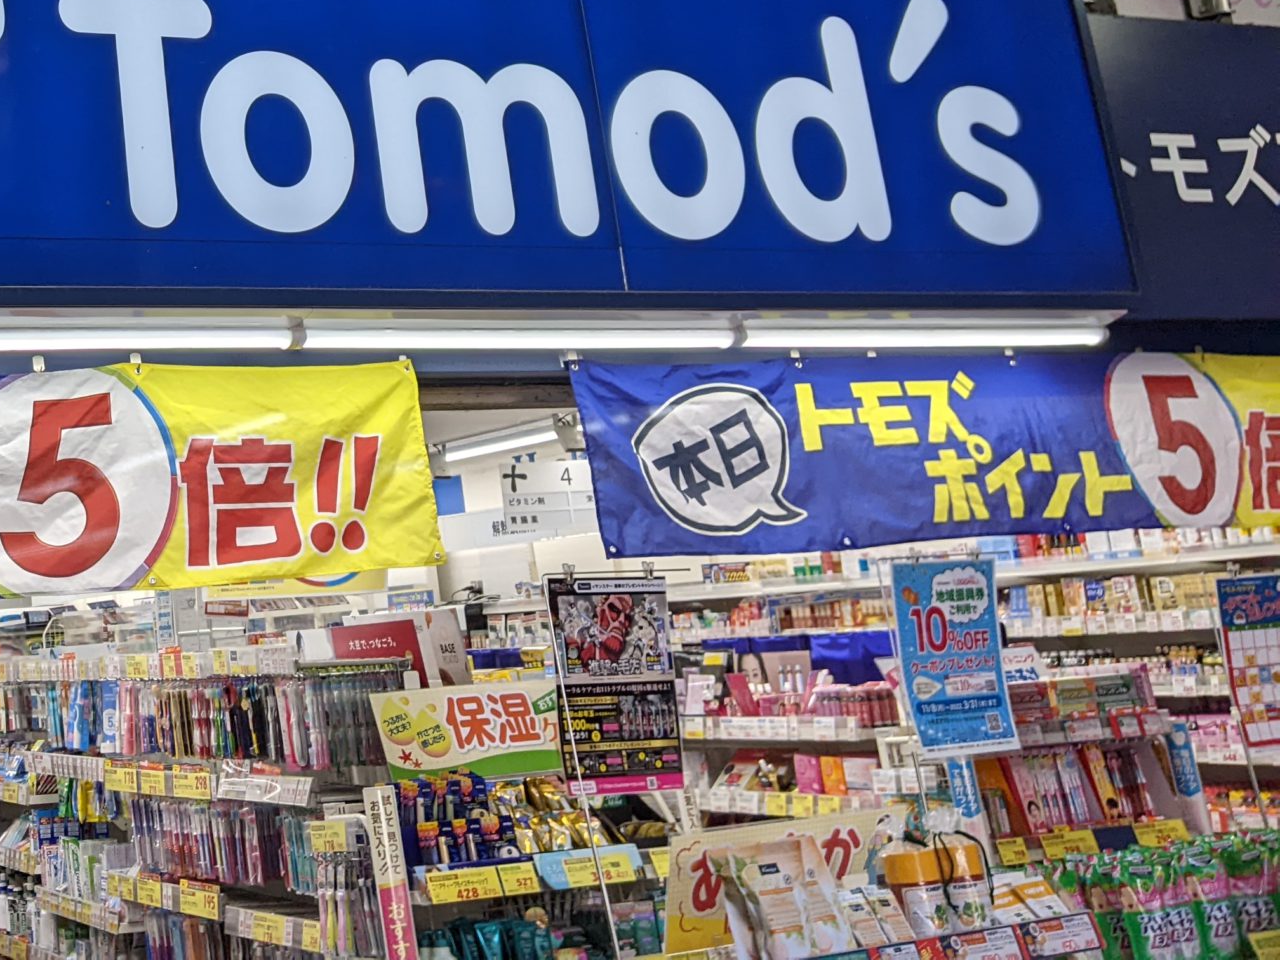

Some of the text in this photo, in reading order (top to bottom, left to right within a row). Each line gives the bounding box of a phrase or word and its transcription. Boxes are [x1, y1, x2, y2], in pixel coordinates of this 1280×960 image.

[1121, 123, 1280, 206] モズ
[794, 370, 975, 451] トモズ
[924, 434, 1132, 523] ポイント
[1141, 375, 1216, 515] 5
[0, 392, 120, 577] 5
[560, 467, 572, 485] 4
[652, 408, 770, 506] 本日
[440, 643, 457, 654] BASE
[456, 887, 481, 899] 428
[590, 869, 613, 882] 38
